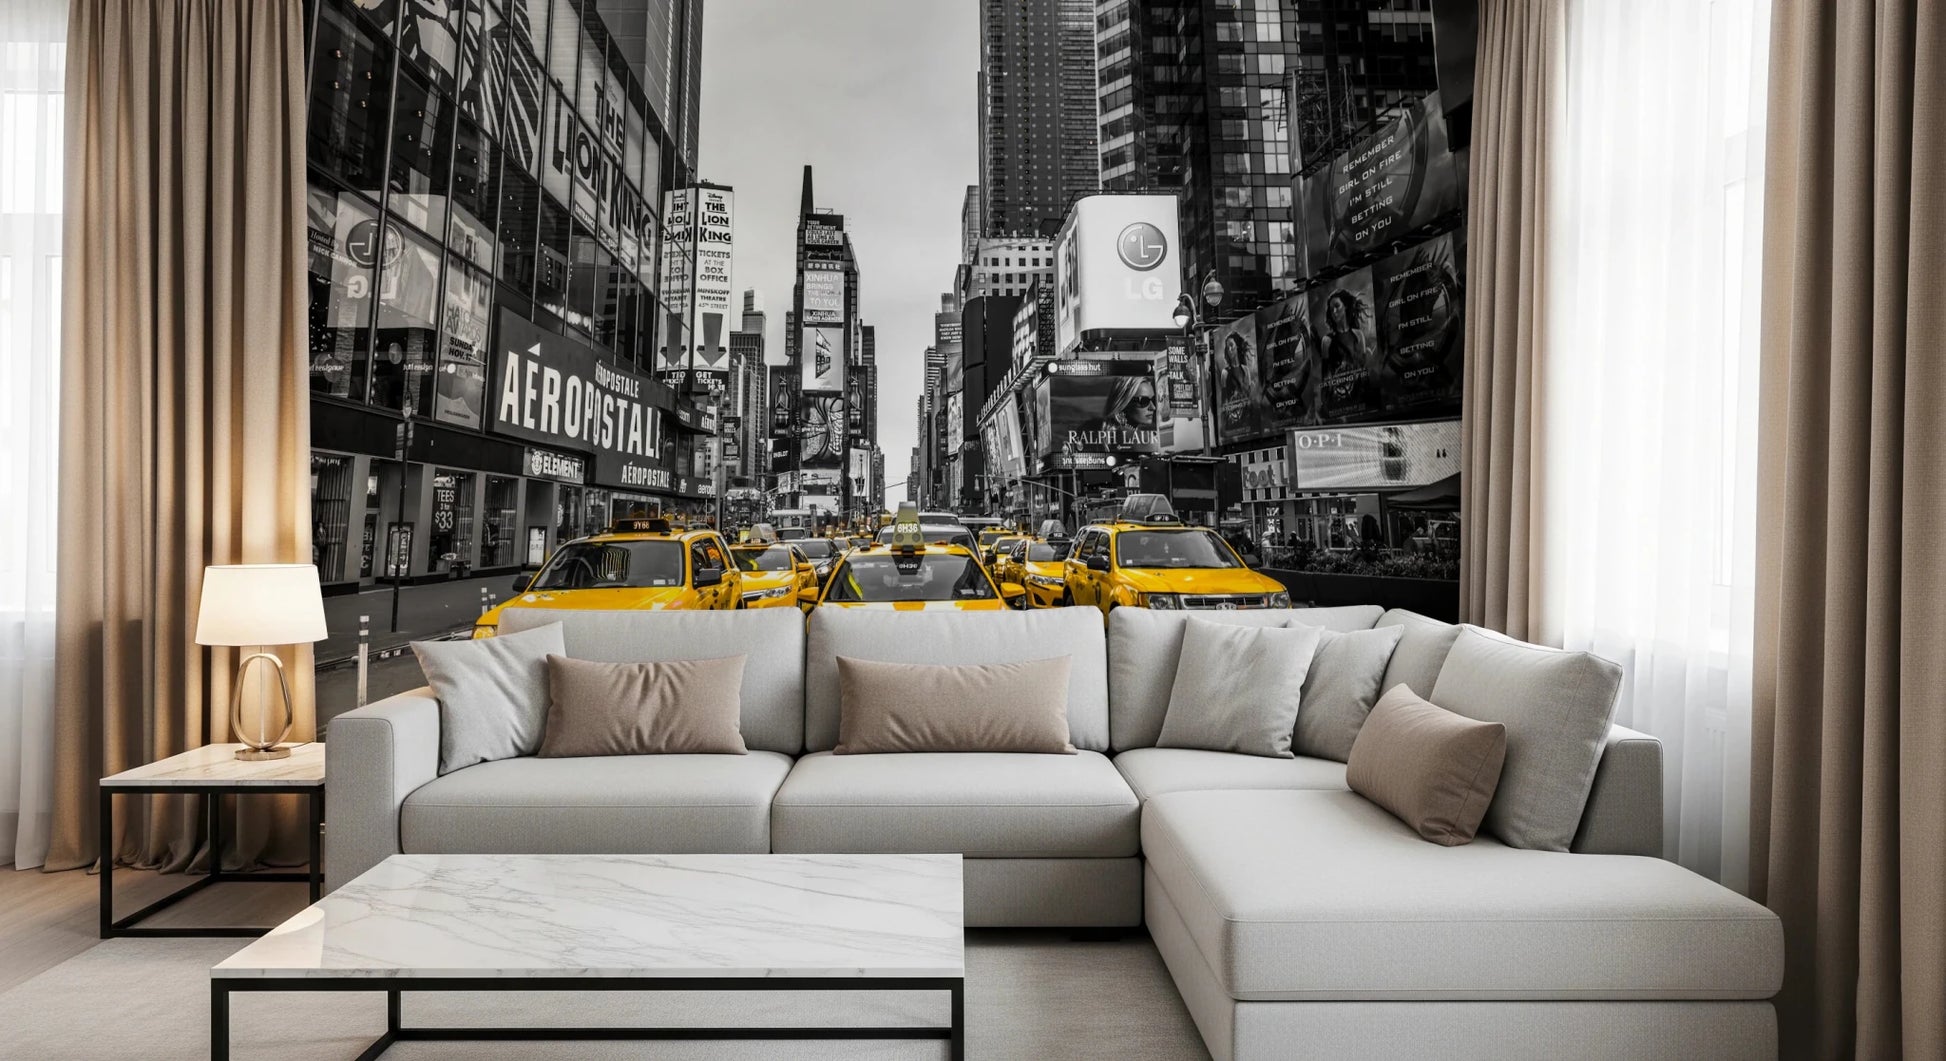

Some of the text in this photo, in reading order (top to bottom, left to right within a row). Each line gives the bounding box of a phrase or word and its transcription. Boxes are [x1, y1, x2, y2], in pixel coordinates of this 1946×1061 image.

[594, 80, 623, 150] THE
[1343, 135, 1394, 174] REMEMBER
[553, 78, 652, 254] LION KING
[1339, 150, 1401, 194] GIRL ON FIRE
[1349, 177, 1393, 206] I'M STILL
[705, 202, 725, 211] THE
[1352, 195, 1393, 224] BETTING
[702, 211, 729, 226] LION
[699, 227, 732, 242] KING
[1355, 216, 1392, 241] ON YOU
[699, 249, 731, 259] TICKETS
[705, 266, 724, 274] BOX
[1390, 262, 1433, 283] REMEMBER
[700, 274, 728, 282] OFFICE
[806, 274, 839, 282] XINHUA
[1124, 277, 1164, 300] LG
[1389, 287, 1438, 308] GIRL ON FIRE
[1409, 315, 1432, 327] STILL
[1168, 346, 1186, 355] SOME
[1400, 340, 1435, 355] BETTING
[1168, 355, 1188, 363] WALLS
[695, 371, 712, 379] GET
[1059, 363, 1101, 373] sunglass hut
[1169, 371, 1184, 380] TALK
[1404, 366, 1435, 379] ON YOU
[1068, 430, 1158, 445] RALPH LAUR
[543, 455, 579, 479] ELEMENT
[621, 461, 670, 488] AÉROPOSTALE
[437, 490, 455, 503] TEES
[435, 511, 453, 529] $33
[897, 523, 918, 533] 6H36
